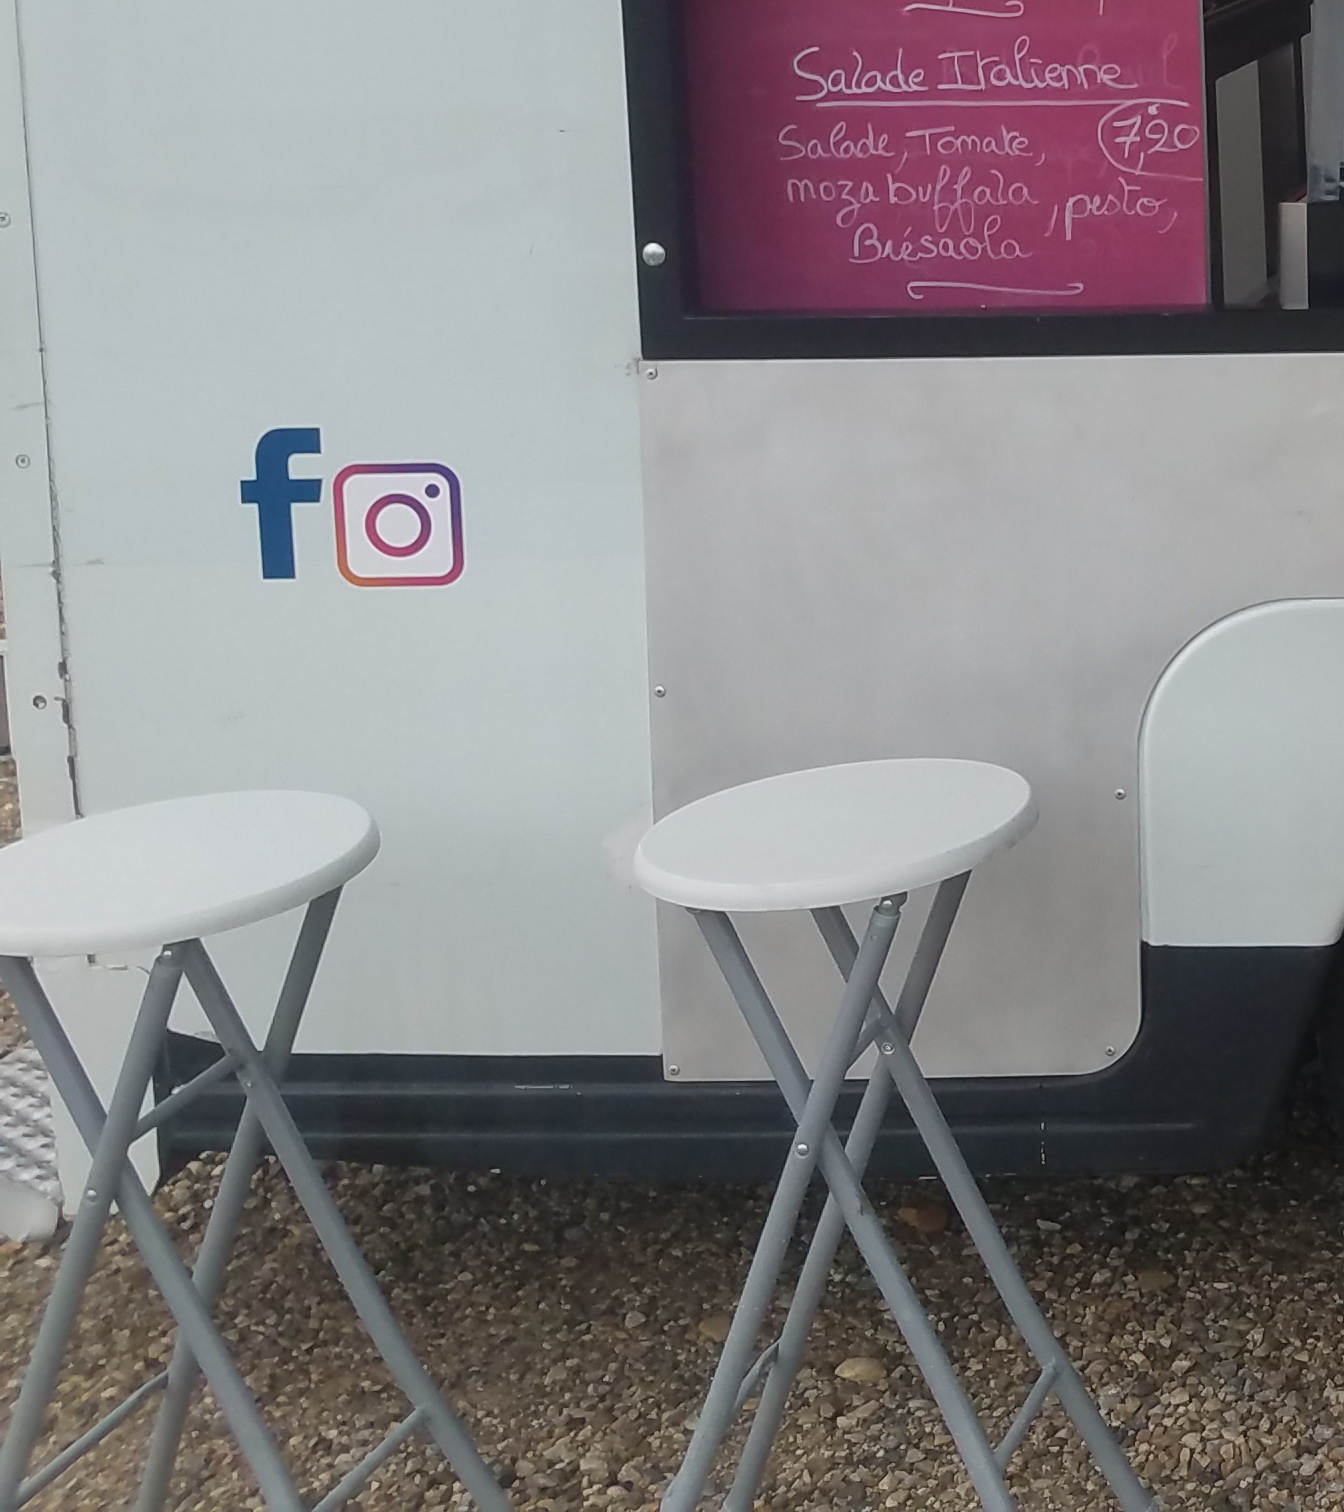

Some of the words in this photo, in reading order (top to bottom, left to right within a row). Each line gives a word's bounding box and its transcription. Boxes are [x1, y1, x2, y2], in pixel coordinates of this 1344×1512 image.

[793, 46, 929, 101] Salade
[937, 36, 1137, 91] Italienne
[788, 176, 879, 228] moza
